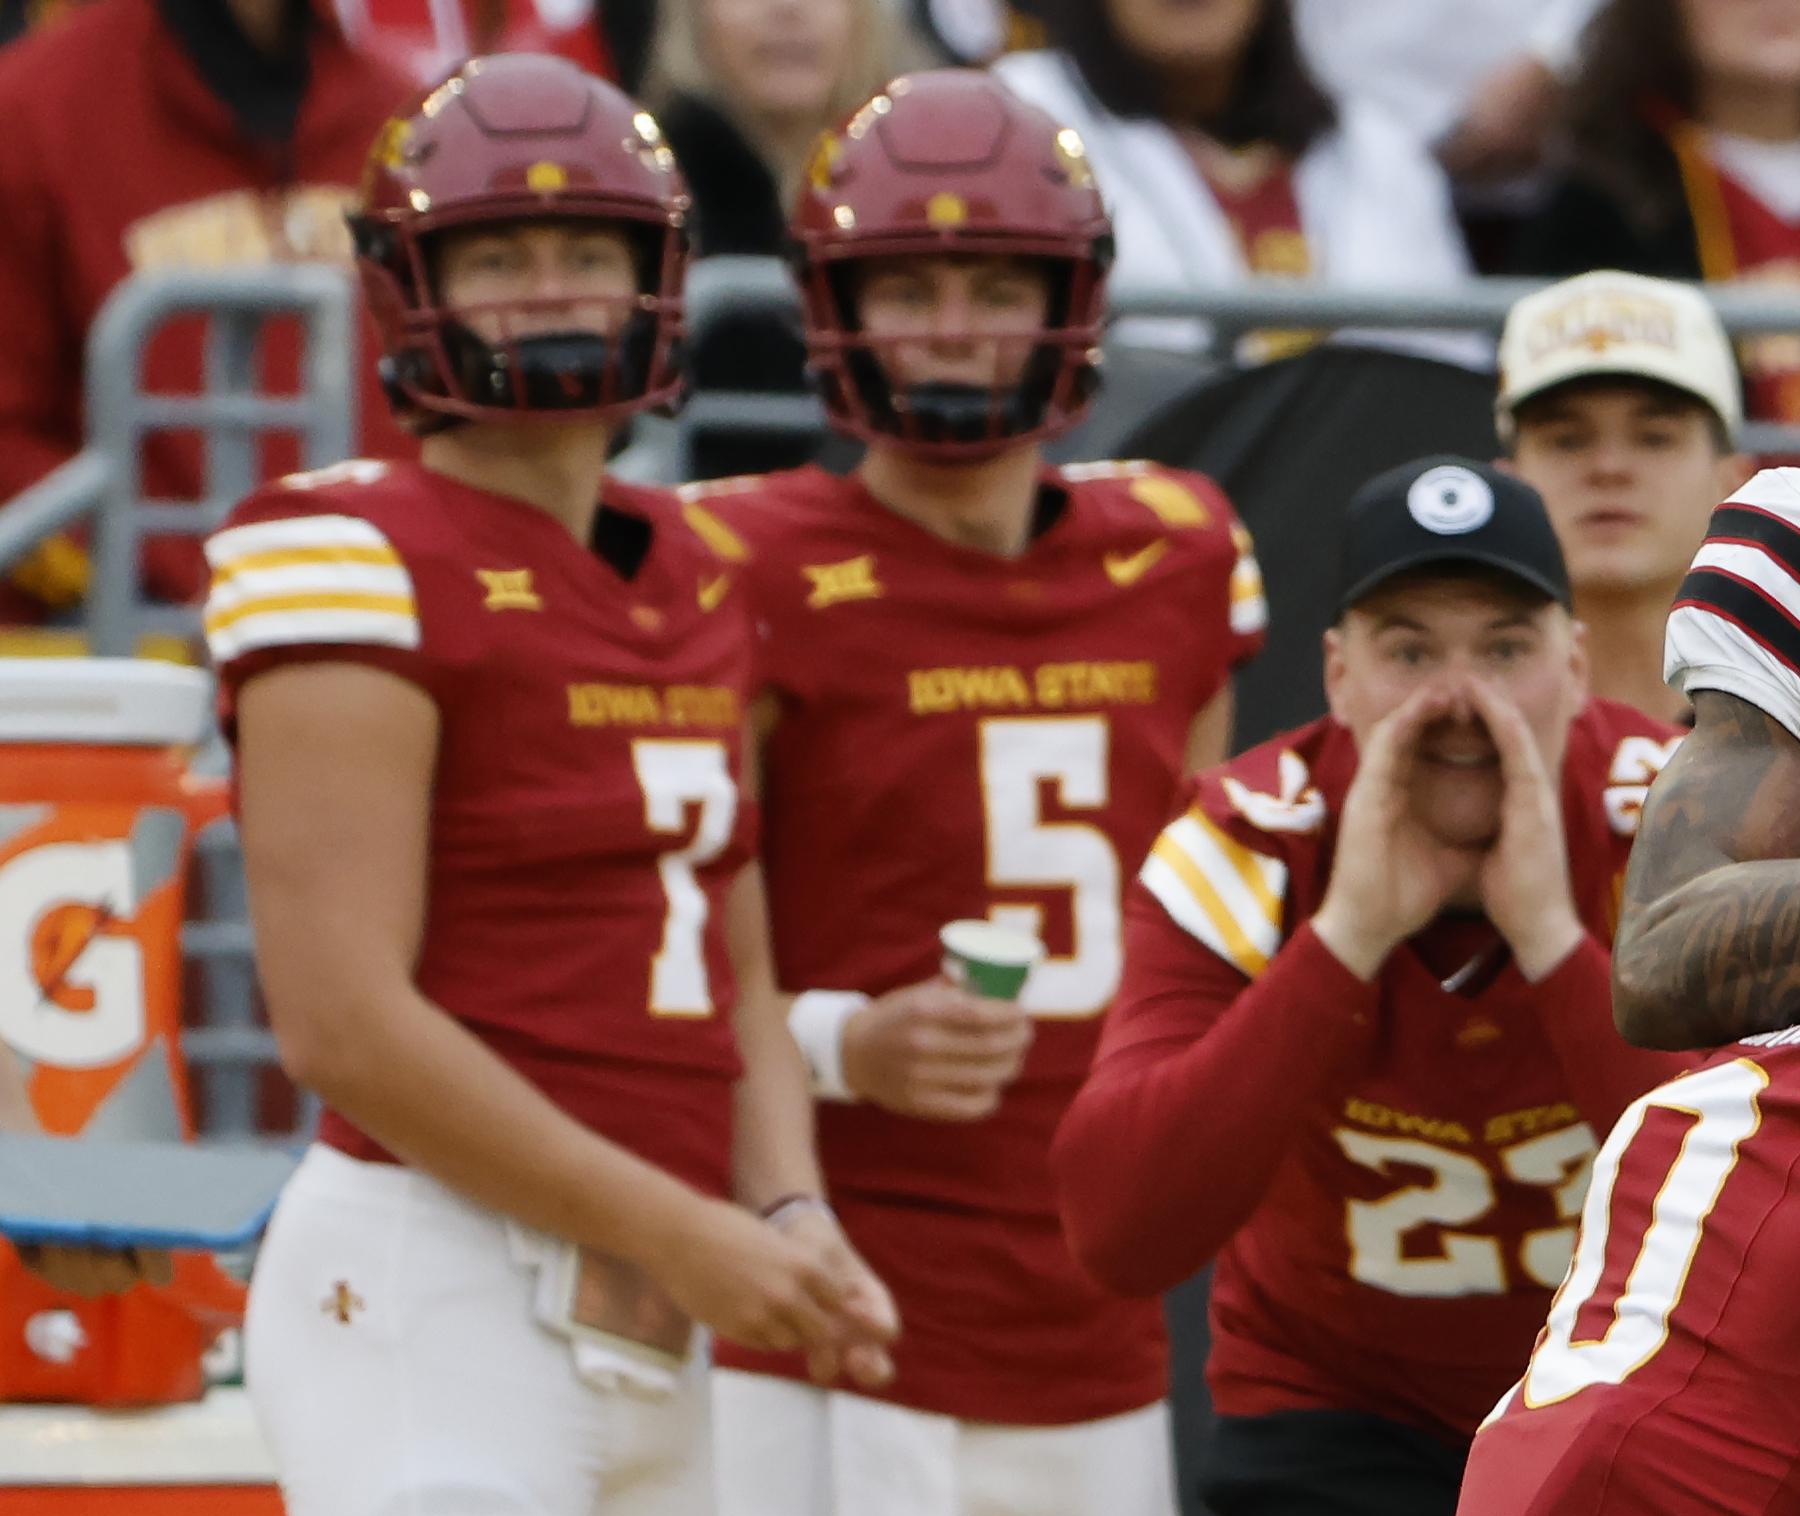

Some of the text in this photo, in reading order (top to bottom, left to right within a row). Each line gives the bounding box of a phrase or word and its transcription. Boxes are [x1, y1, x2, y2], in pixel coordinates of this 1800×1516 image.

[566, 683, 660, 728] IOWA
[908, 659, 1157, 715] IOWA STATE
[0, 840, 148, 1071] G
[630, 736, 739, 1019] 7
[976, 713, 1124, 1021] 5
[1334, 1118, 1600, 1297] 23
